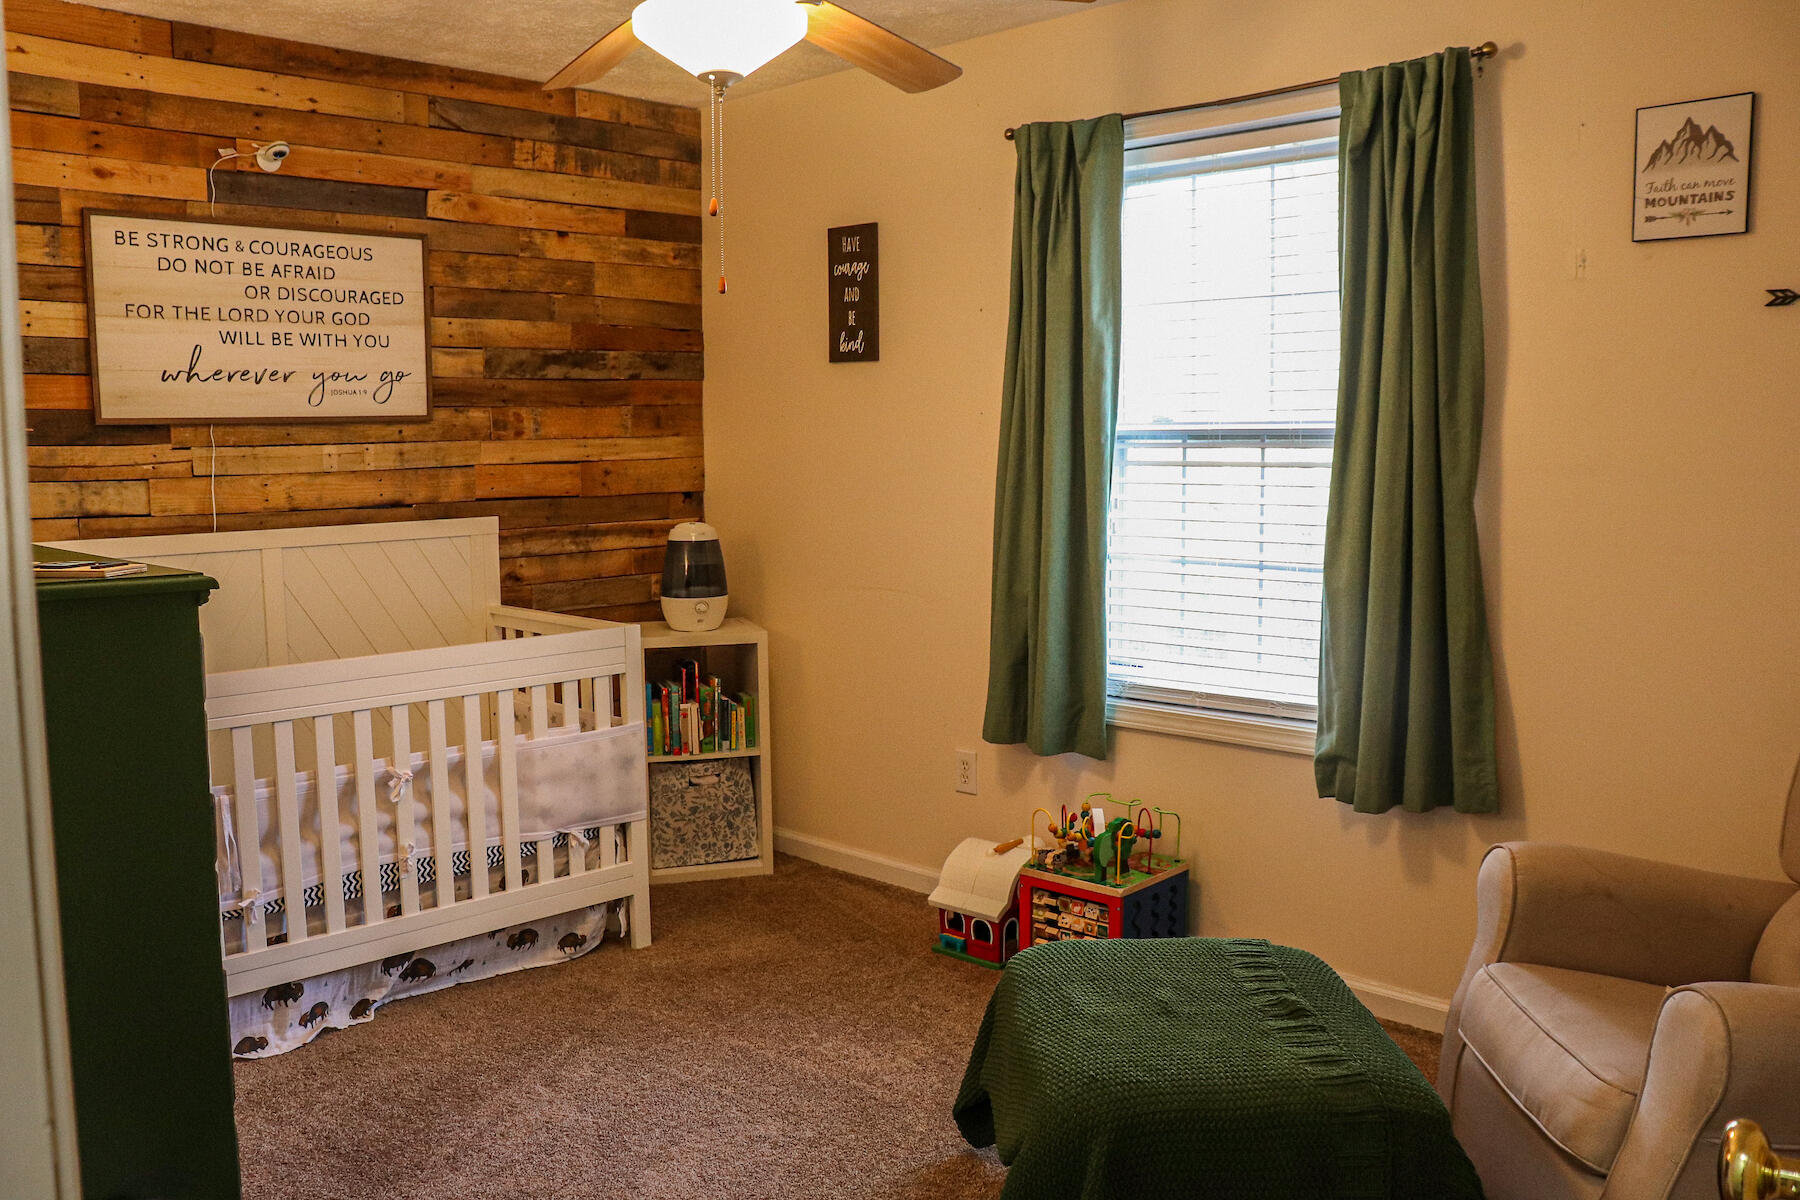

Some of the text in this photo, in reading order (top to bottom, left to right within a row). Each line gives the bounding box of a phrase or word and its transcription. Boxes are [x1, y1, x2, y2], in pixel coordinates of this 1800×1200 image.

[1646, 178, 1736, 194] Faith can move
[1645, 191, 1735, 208] MOUNTAINS
[114, 230, 373, 261] BE STRONG & COURAGEOUS
[842, 236, 860, 252] HAVE
[157, 257, 336, 280] DO NOT BE AFRAID
[833, 262, 870, 281] courage
[244, 285, 404, 305] OR DISCOURAGED
[844, 287, 860, 302] AND
[125, 304, 370, 326] FOR THE LORD YOUR GOD
[848, 311, 855, 326] BE
[219, 330, 390, 348] WILL BE WITH YOU
[840, 330, 864, 353] kind
[161, 345, 412, 407] wherever you go
